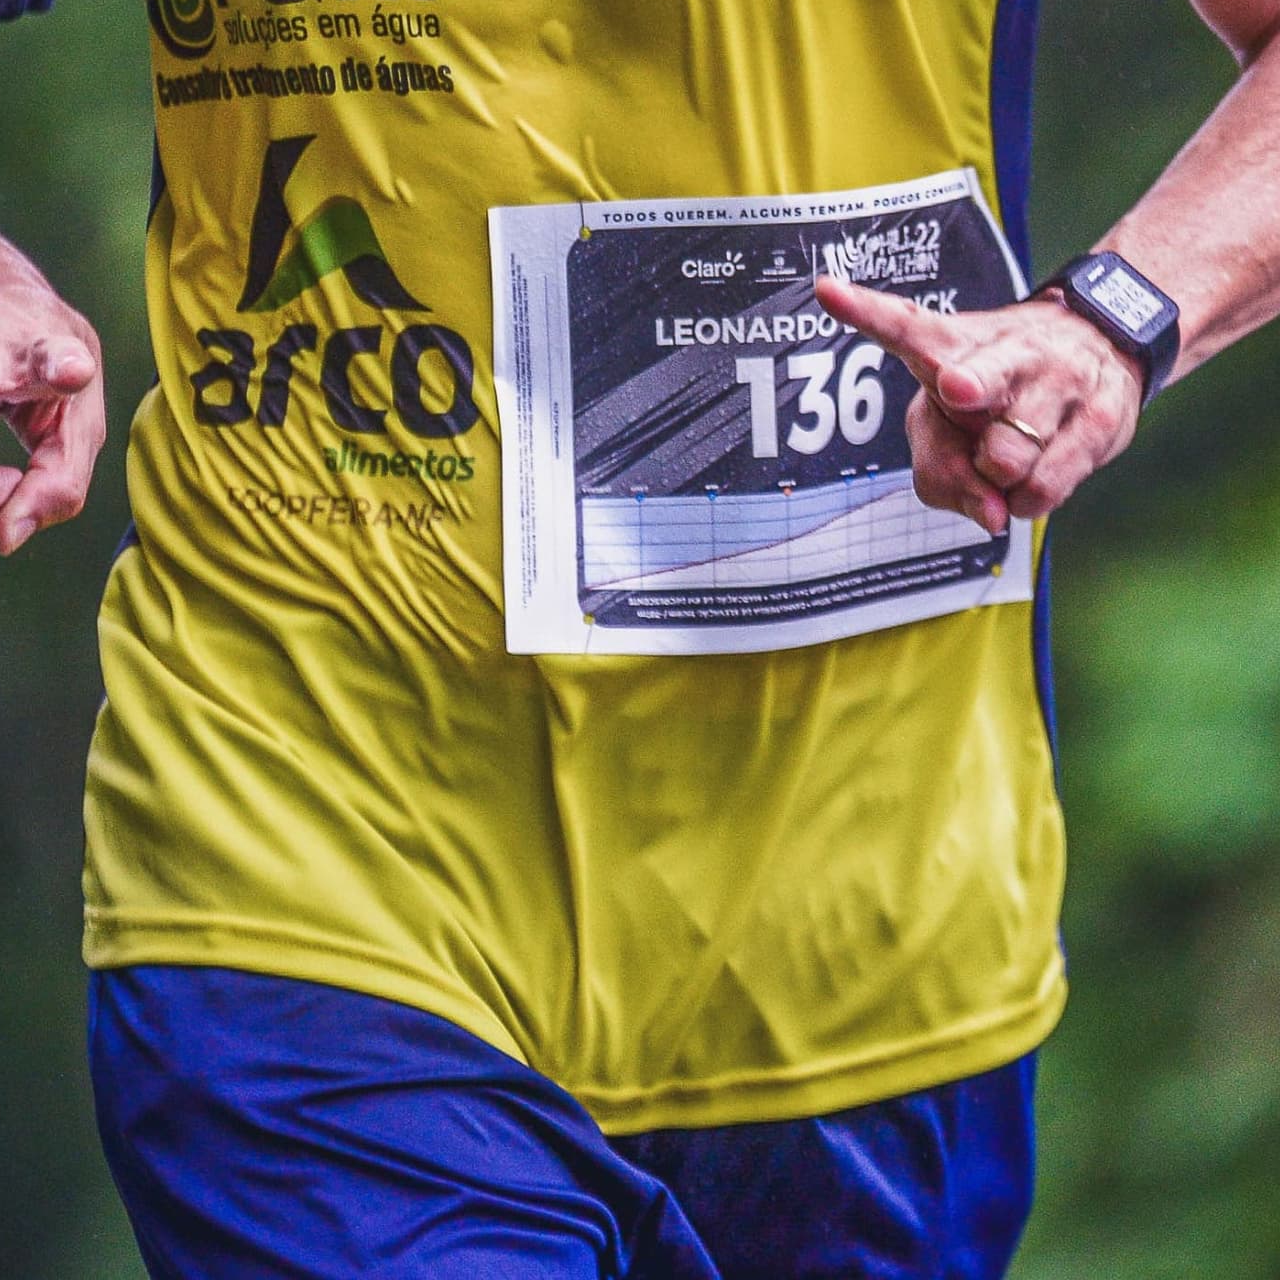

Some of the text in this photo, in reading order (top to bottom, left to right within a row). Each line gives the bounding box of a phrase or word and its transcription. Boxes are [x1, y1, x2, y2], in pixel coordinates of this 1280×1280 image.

[317, 13, 361, 38] em
[371, 3, 440, 45] água
[340, 56, 374, 92] de
[375, 55, 454, 97] águas
[603, 211, 657, 224] TODOS
[663, 208, 733, 223] QUEREM.
[739, 205, 802, 219] ALGUNS
[681, 258, 737, 278] Claro
[655, 313, 833, 346] LEONARDO
[190, 323, 480, 440] arco
[735, 343, 885, 459] 136
[322, 439, 475, 482] alimentos
